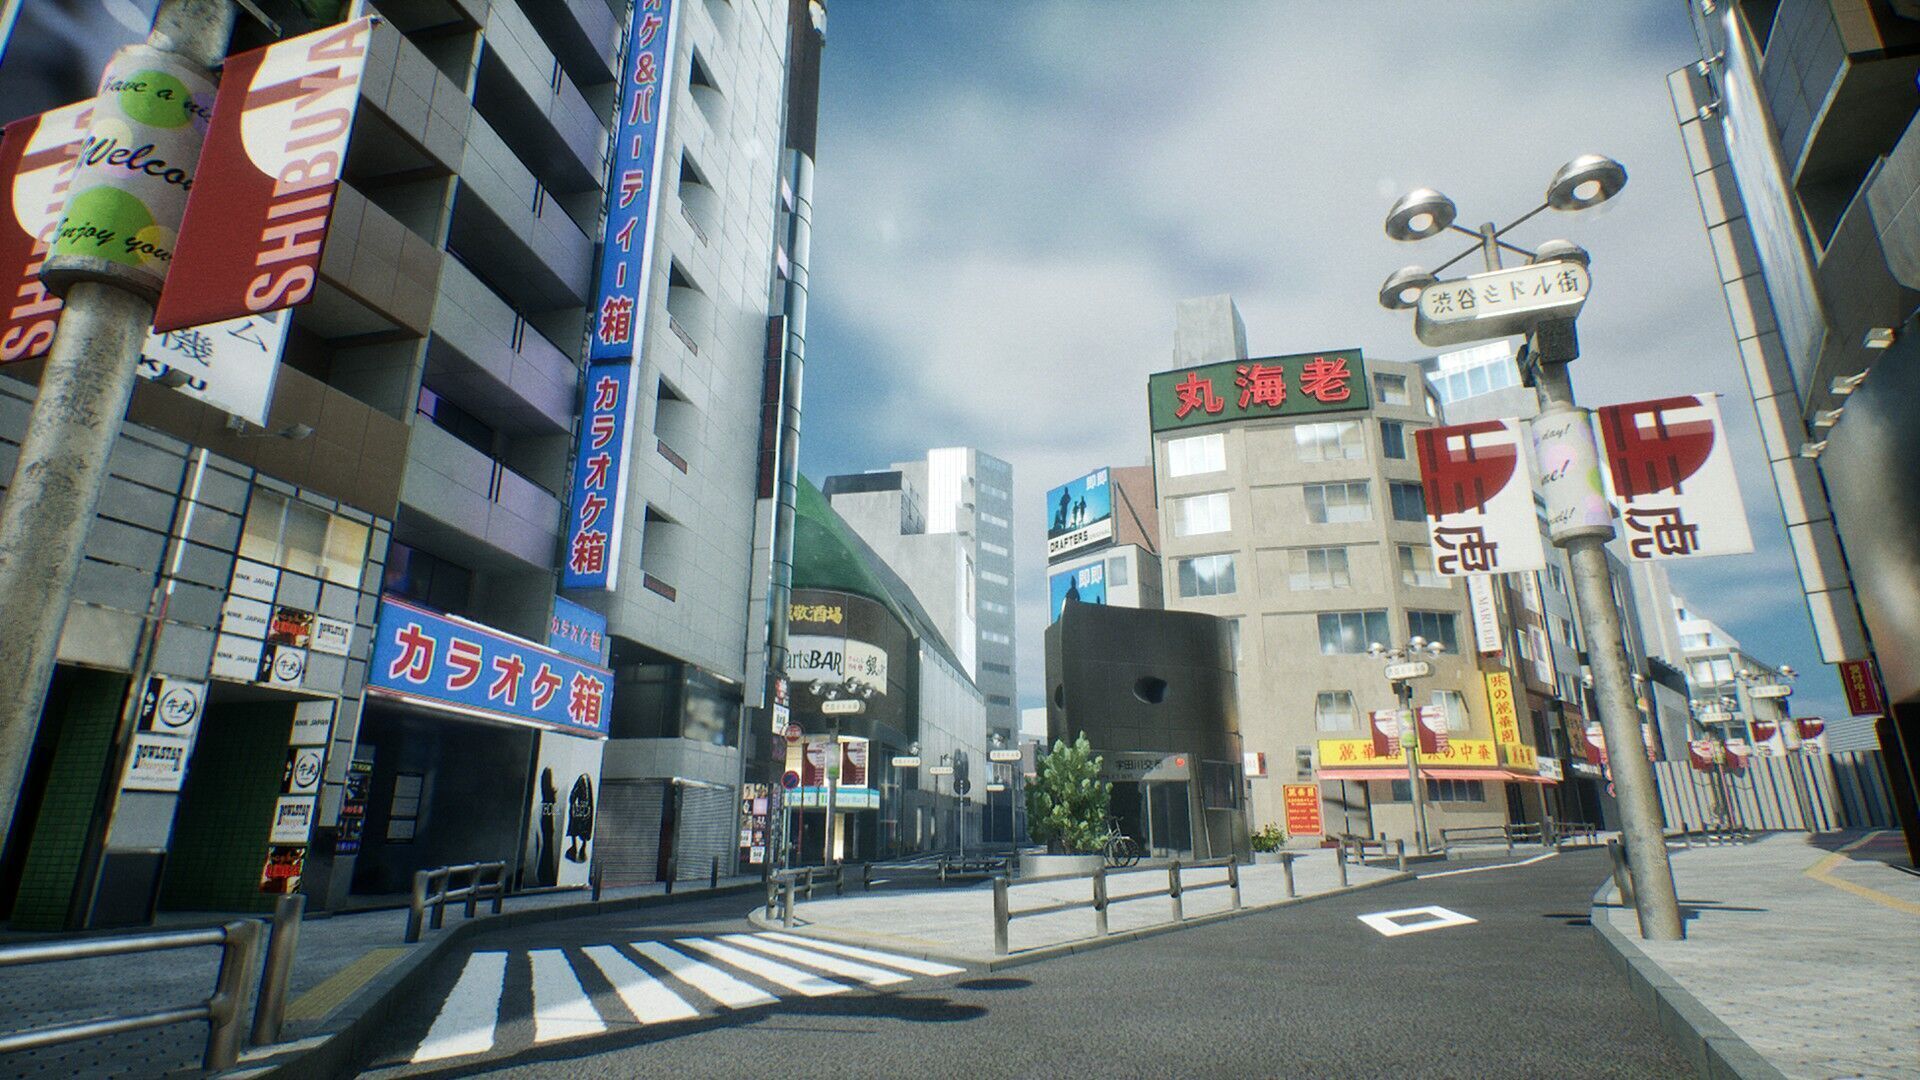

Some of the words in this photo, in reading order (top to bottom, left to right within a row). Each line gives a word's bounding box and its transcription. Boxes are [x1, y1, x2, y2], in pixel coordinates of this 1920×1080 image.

[244, 18, 370, 311] SHIBUYA
[1431, 269, 1579, 314] 渋谷ミドル街
[1174, 356, 1351, 419] 丸海老
[571, 375, 619, 576] カラオケ箱
[389, 622, 605, 727] カラオケ箱
